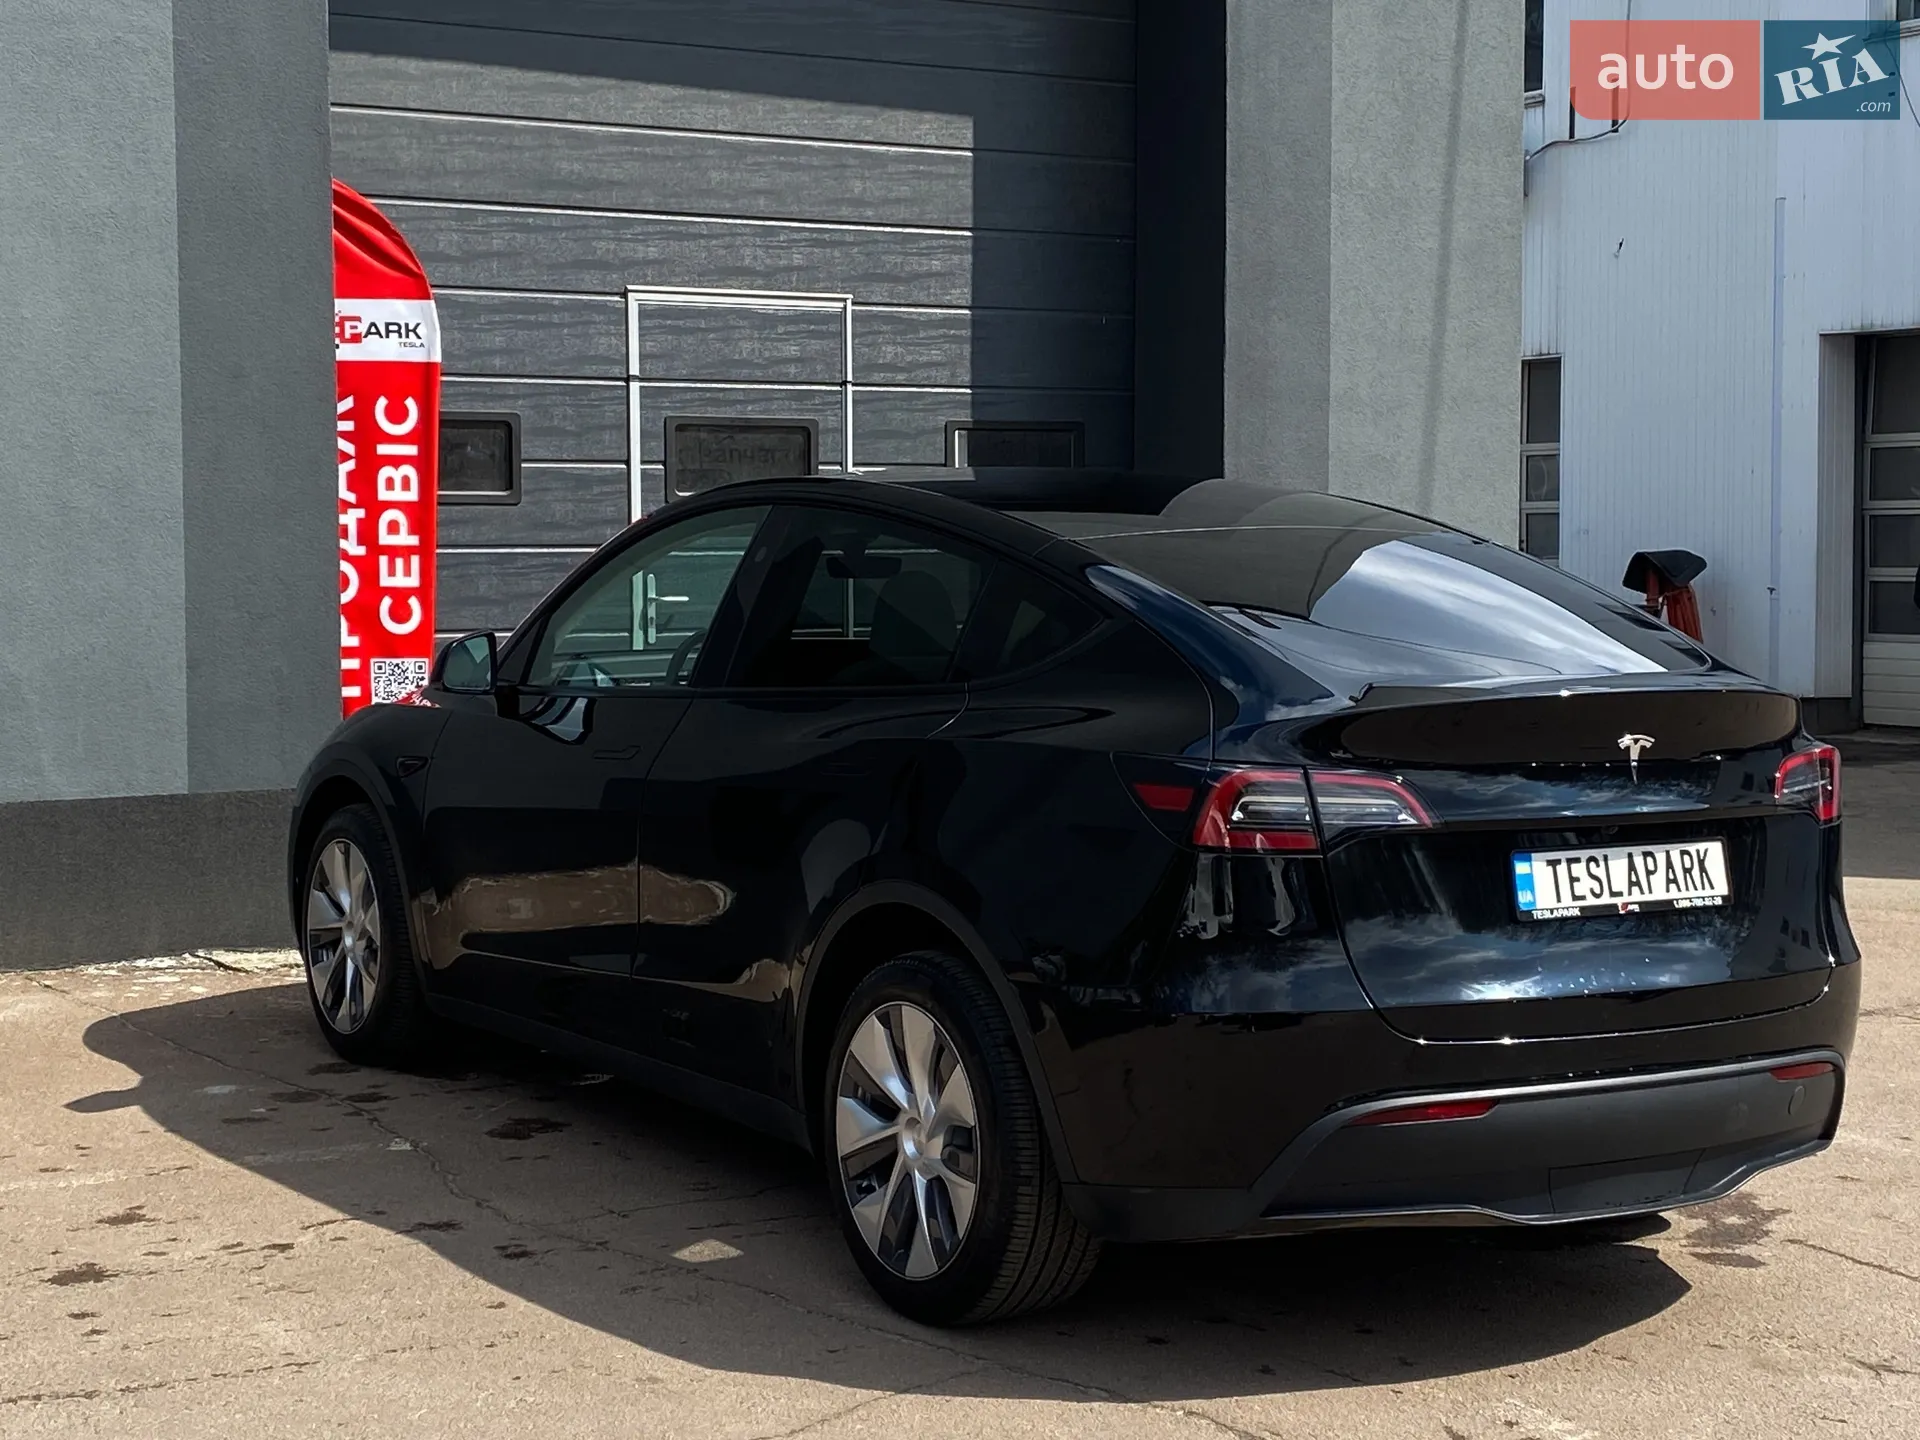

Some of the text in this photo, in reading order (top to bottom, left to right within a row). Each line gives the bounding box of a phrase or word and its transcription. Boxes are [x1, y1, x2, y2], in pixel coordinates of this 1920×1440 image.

[374, 395, 422, 635] СЕРВІС
[1546, 848, 1715, 903] TESLAPARK
[1518, 890, 1534, 904] UA
[1531, 907, 1581, 919] TESLAPARK
